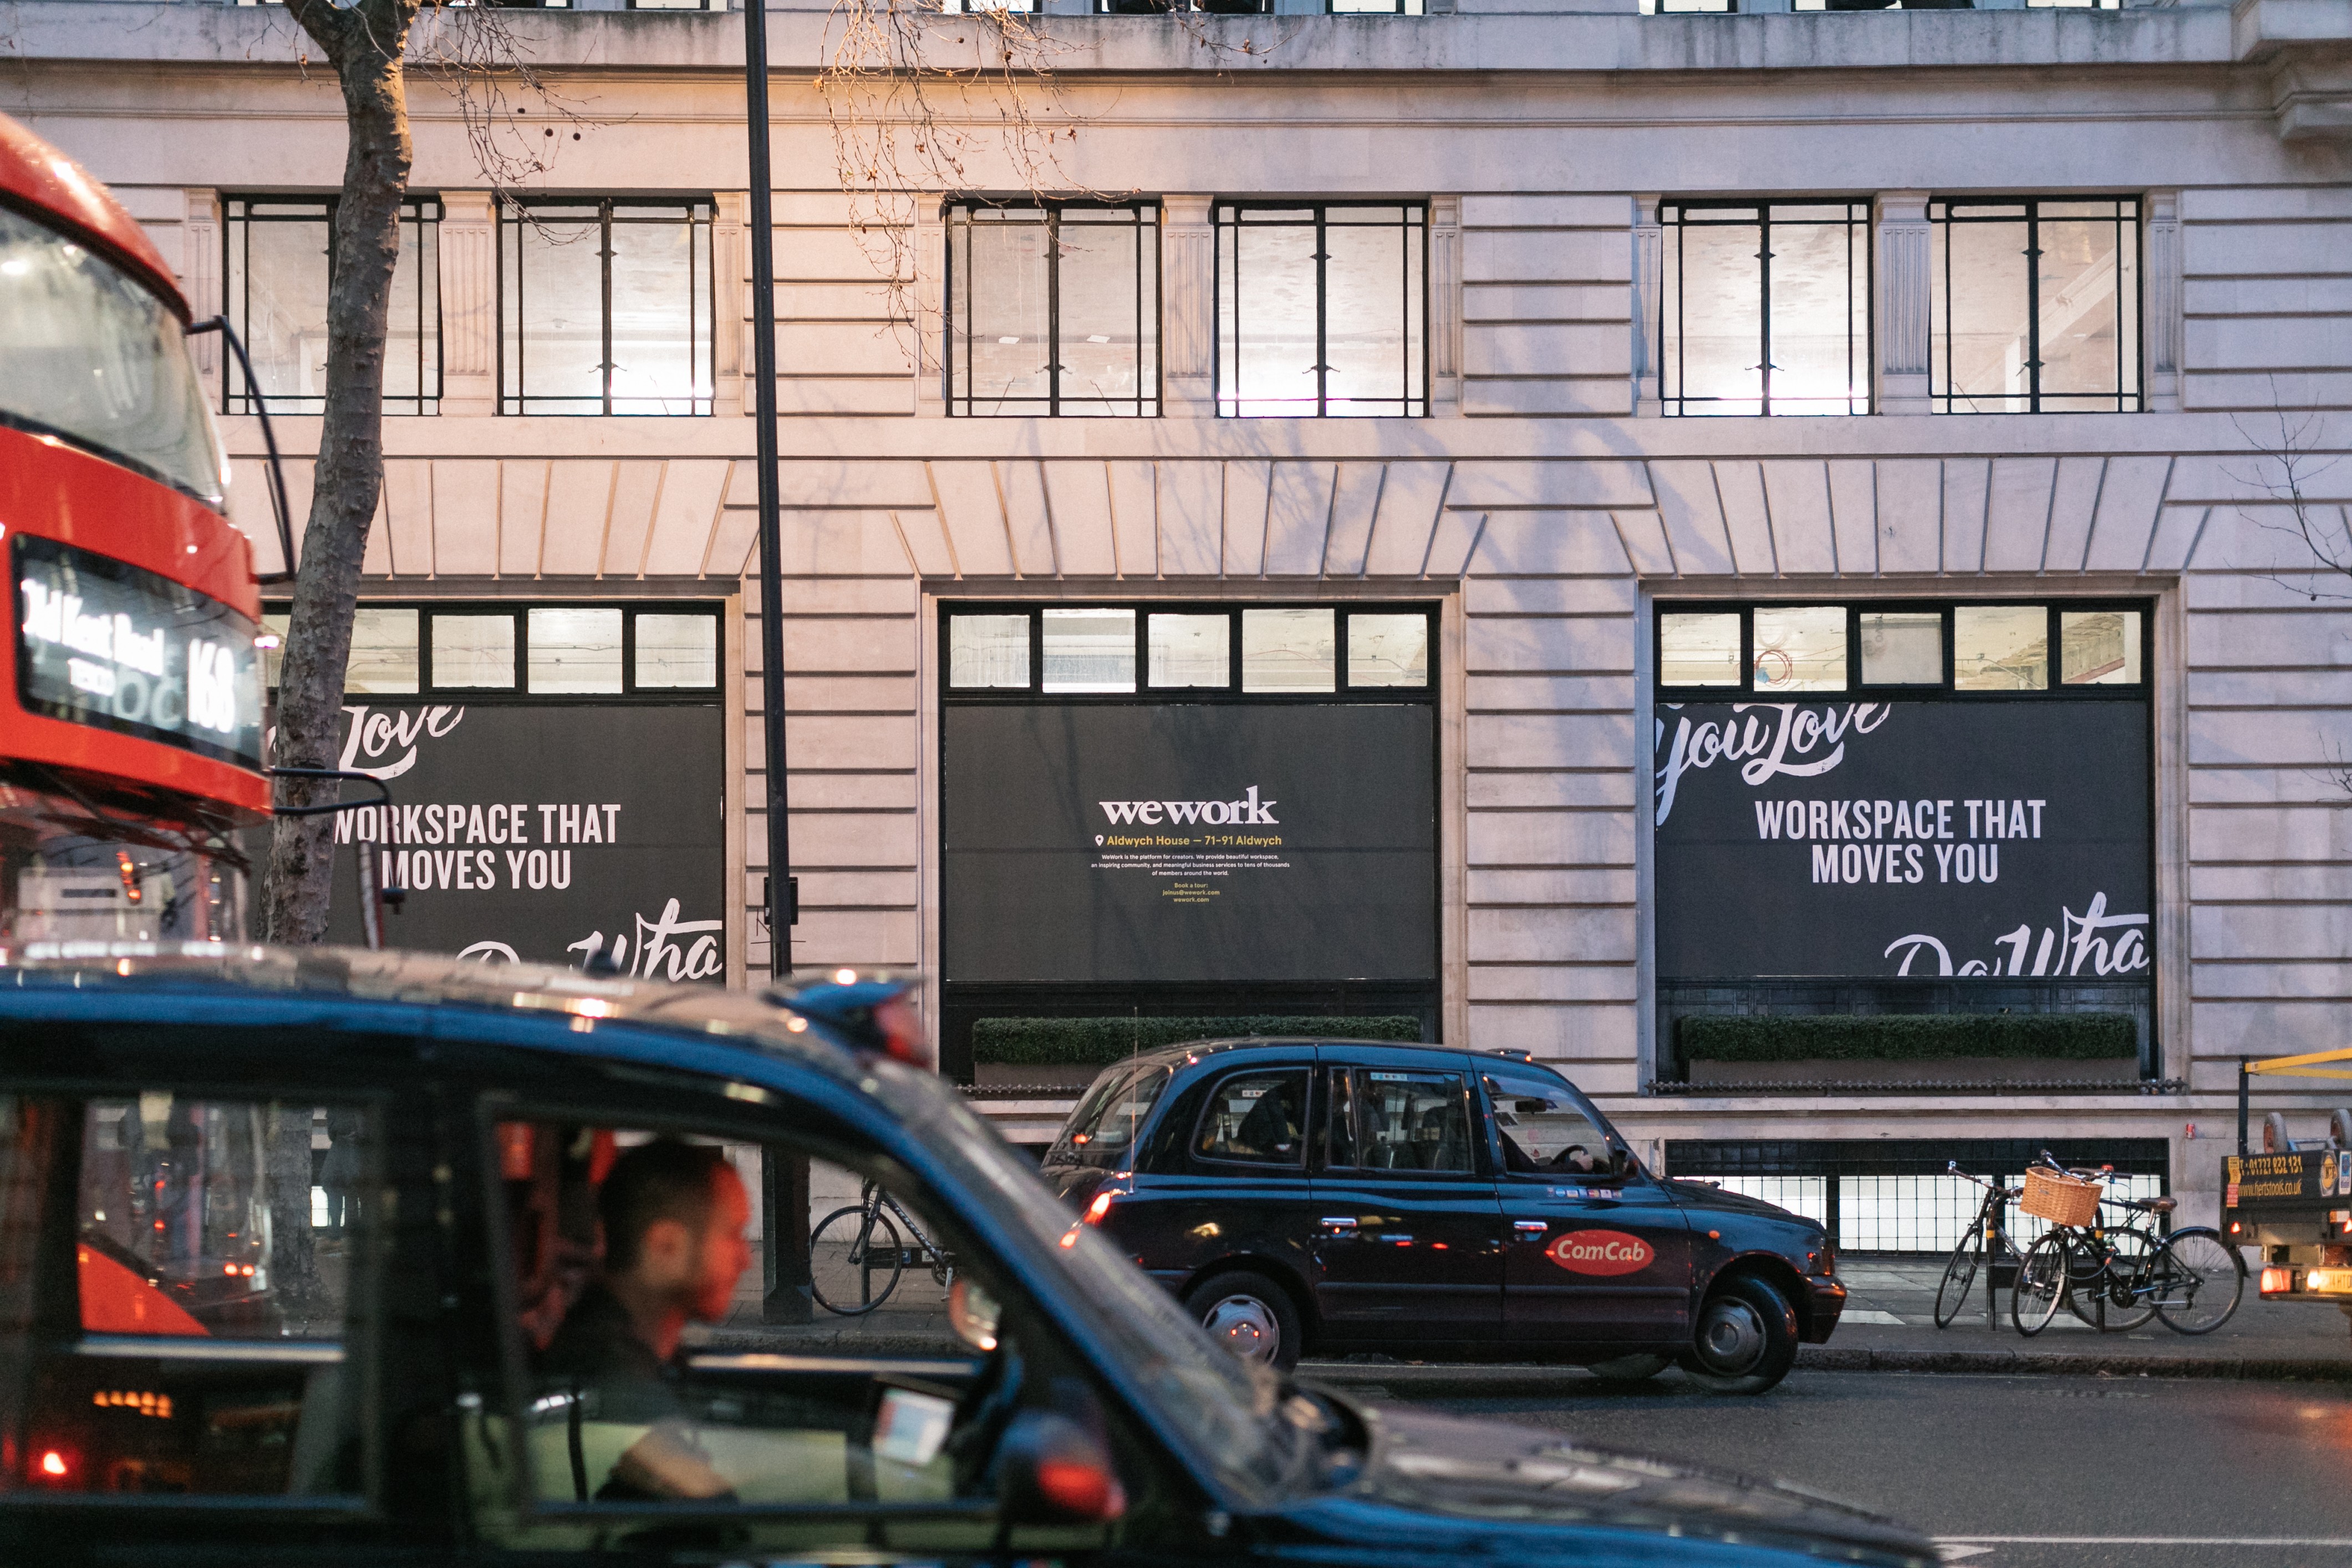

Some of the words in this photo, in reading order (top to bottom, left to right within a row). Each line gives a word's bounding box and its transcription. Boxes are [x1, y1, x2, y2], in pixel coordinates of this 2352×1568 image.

[188, 638, 236, 733] 168
[1733, 703, 1892, 786] Love
[334, 804, 528, 844] WORKSPACE
[538, 804, 621, 843] THAT
[1098, 785, 1280, 825] wework
[1755, 800, 1954, 839] WORKSPACE
[1964, 800, 2046, 838] THAT
[1107, 836, 1153, 847] Aldwych
[1156, 836, 1190, 846] House
[1236, 835, 1282, 847] Aldwych
[382, 849, 496, 890] MOVES
[506, 849, 571, 889] YOU
[1812, 843, 1923, 884] MOVES
[1933, 843, 1998, 883] YOU
[2249, 1158, 2272, 1175] 01727
[2238, 1178, 2302, 1197] www.hertstools.co.uk
[1557, 1239, 1645, 1262] ComCab
